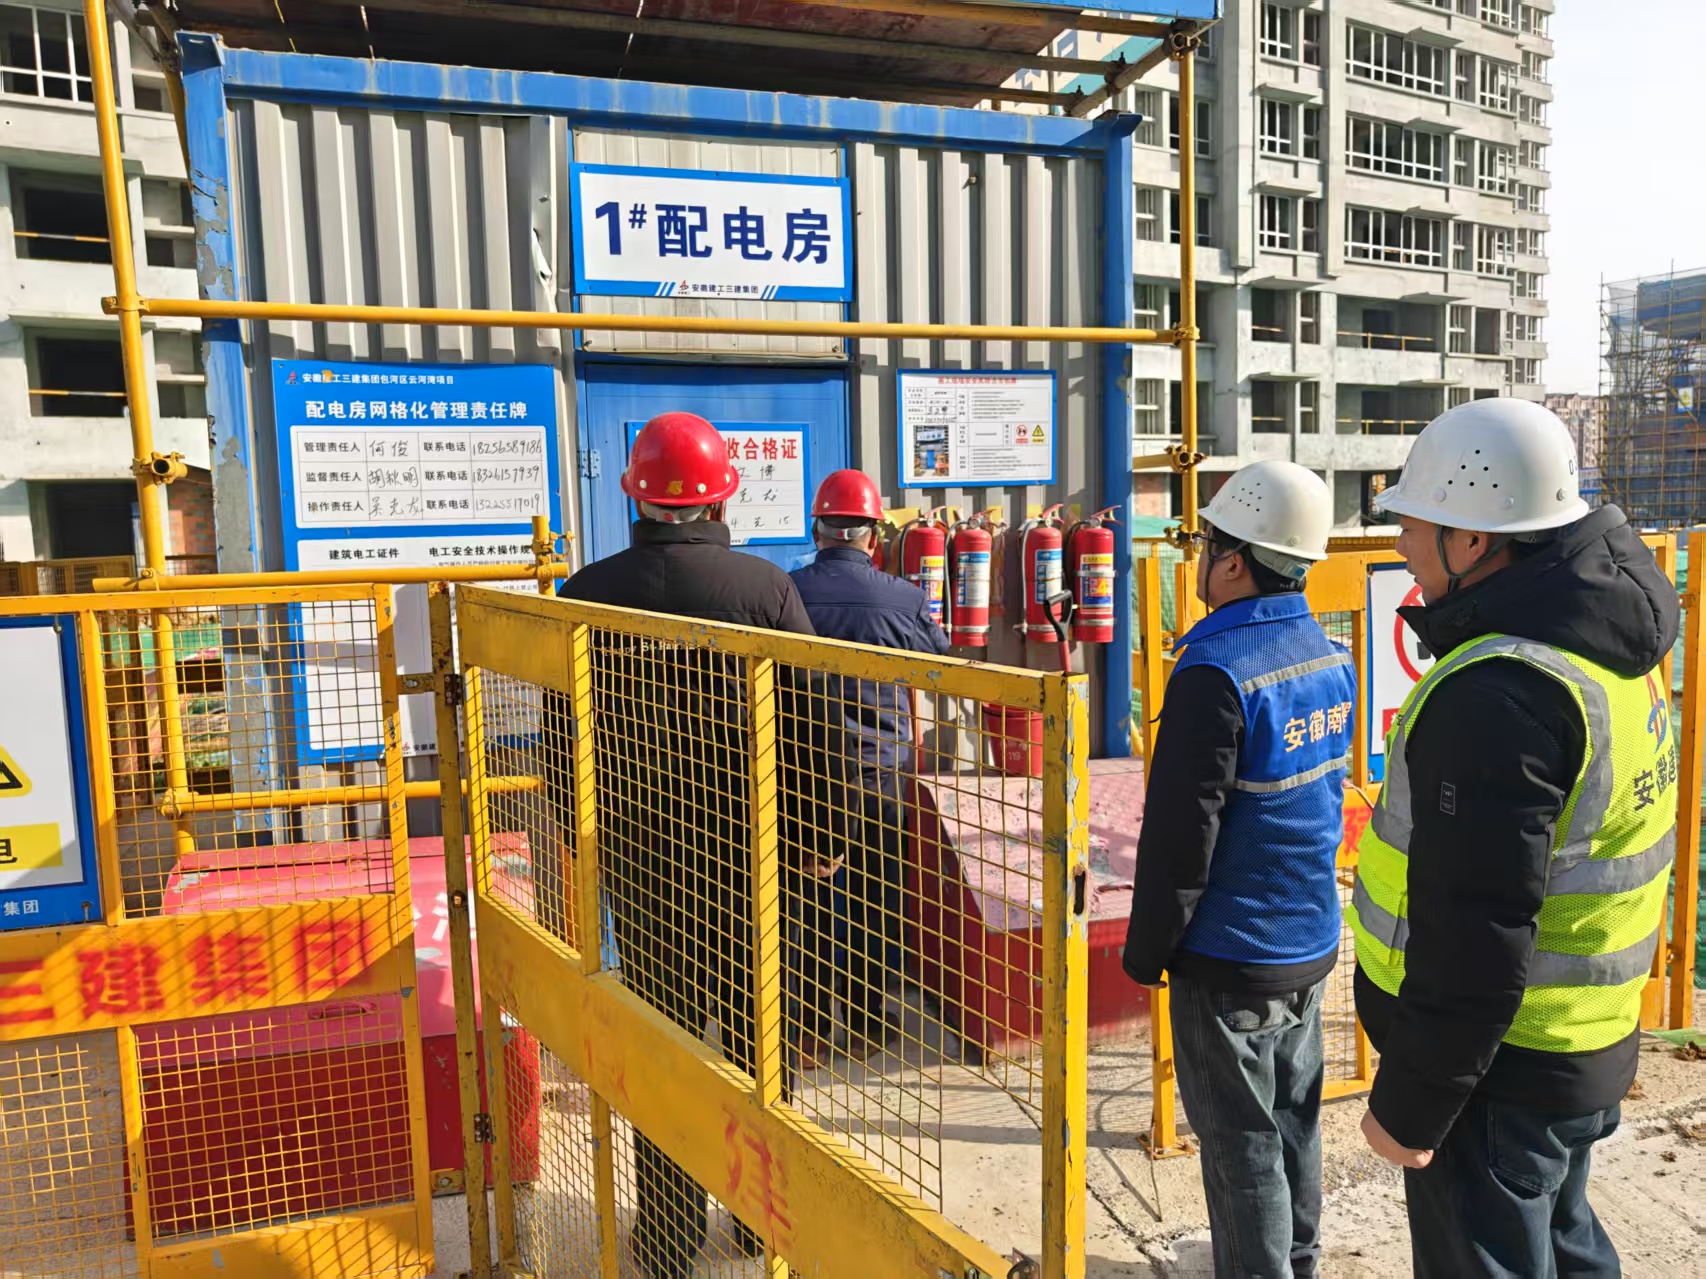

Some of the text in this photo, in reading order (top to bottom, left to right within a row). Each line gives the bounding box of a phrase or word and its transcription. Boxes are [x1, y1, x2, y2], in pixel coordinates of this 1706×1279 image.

[595, 201, 831, 264] 1#配电房
[692, 283, 759, 294] 安徽建工三建集团
[305, 400, 528, 420] 配电房网格化管理责任牌
[303, 442, 360, 453] 管理责任人
[423, 441, 467, 452] 联系电话
[305, 471, 362, 483] 监督责任人
[424, 470, 468, 482] 联系电话
[307, 501, 364, 513] 操作责任人
[426, 498, 469, 511] 联系电话
[329, 548, 400, 560] 建筑电工证件
[0, 899, 39, 916] 集团
